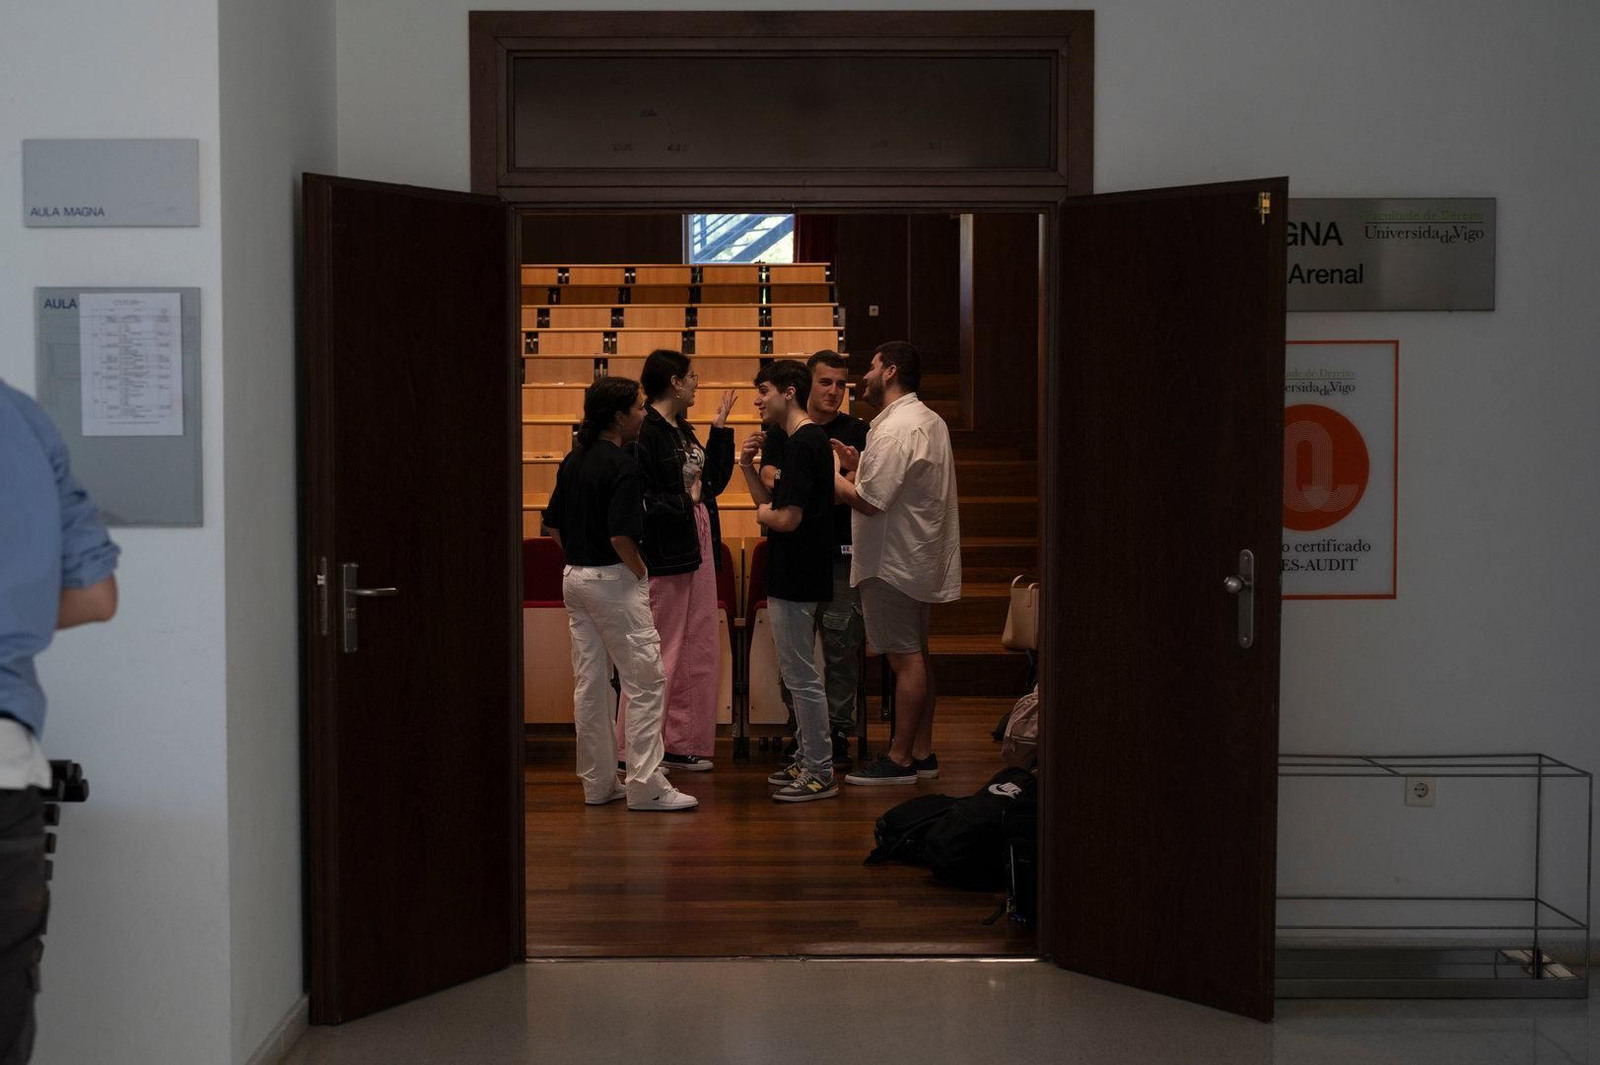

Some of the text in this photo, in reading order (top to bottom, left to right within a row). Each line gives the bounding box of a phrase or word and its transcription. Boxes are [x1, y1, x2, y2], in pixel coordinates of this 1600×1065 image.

[30, 206, 105, 217] AULA MAGNA
[1288, 263, 1364, 284] Arenal
[43, 298, 78, 309] AULA
[1294, 538, 1371, 553] certificado
